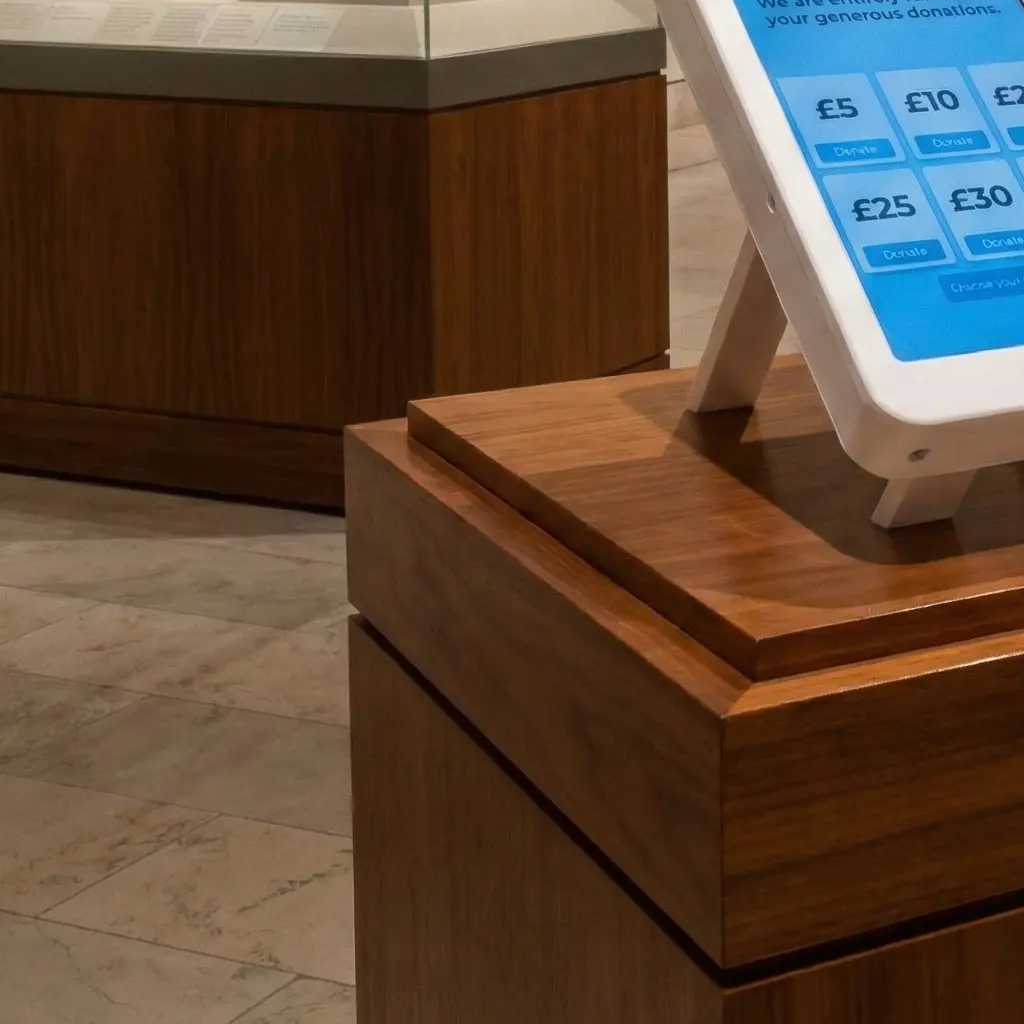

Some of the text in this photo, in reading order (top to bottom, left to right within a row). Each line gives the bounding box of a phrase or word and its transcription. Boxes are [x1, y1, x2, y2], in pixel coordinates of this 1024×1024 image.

[765, 6, 1001, 28] your generous donations.
[816, 97, 859, 120] £5
[904, 89, 960, 113] £10
[852, 194, 916, 222] £25
[949, 185, 1013, 212] £30
